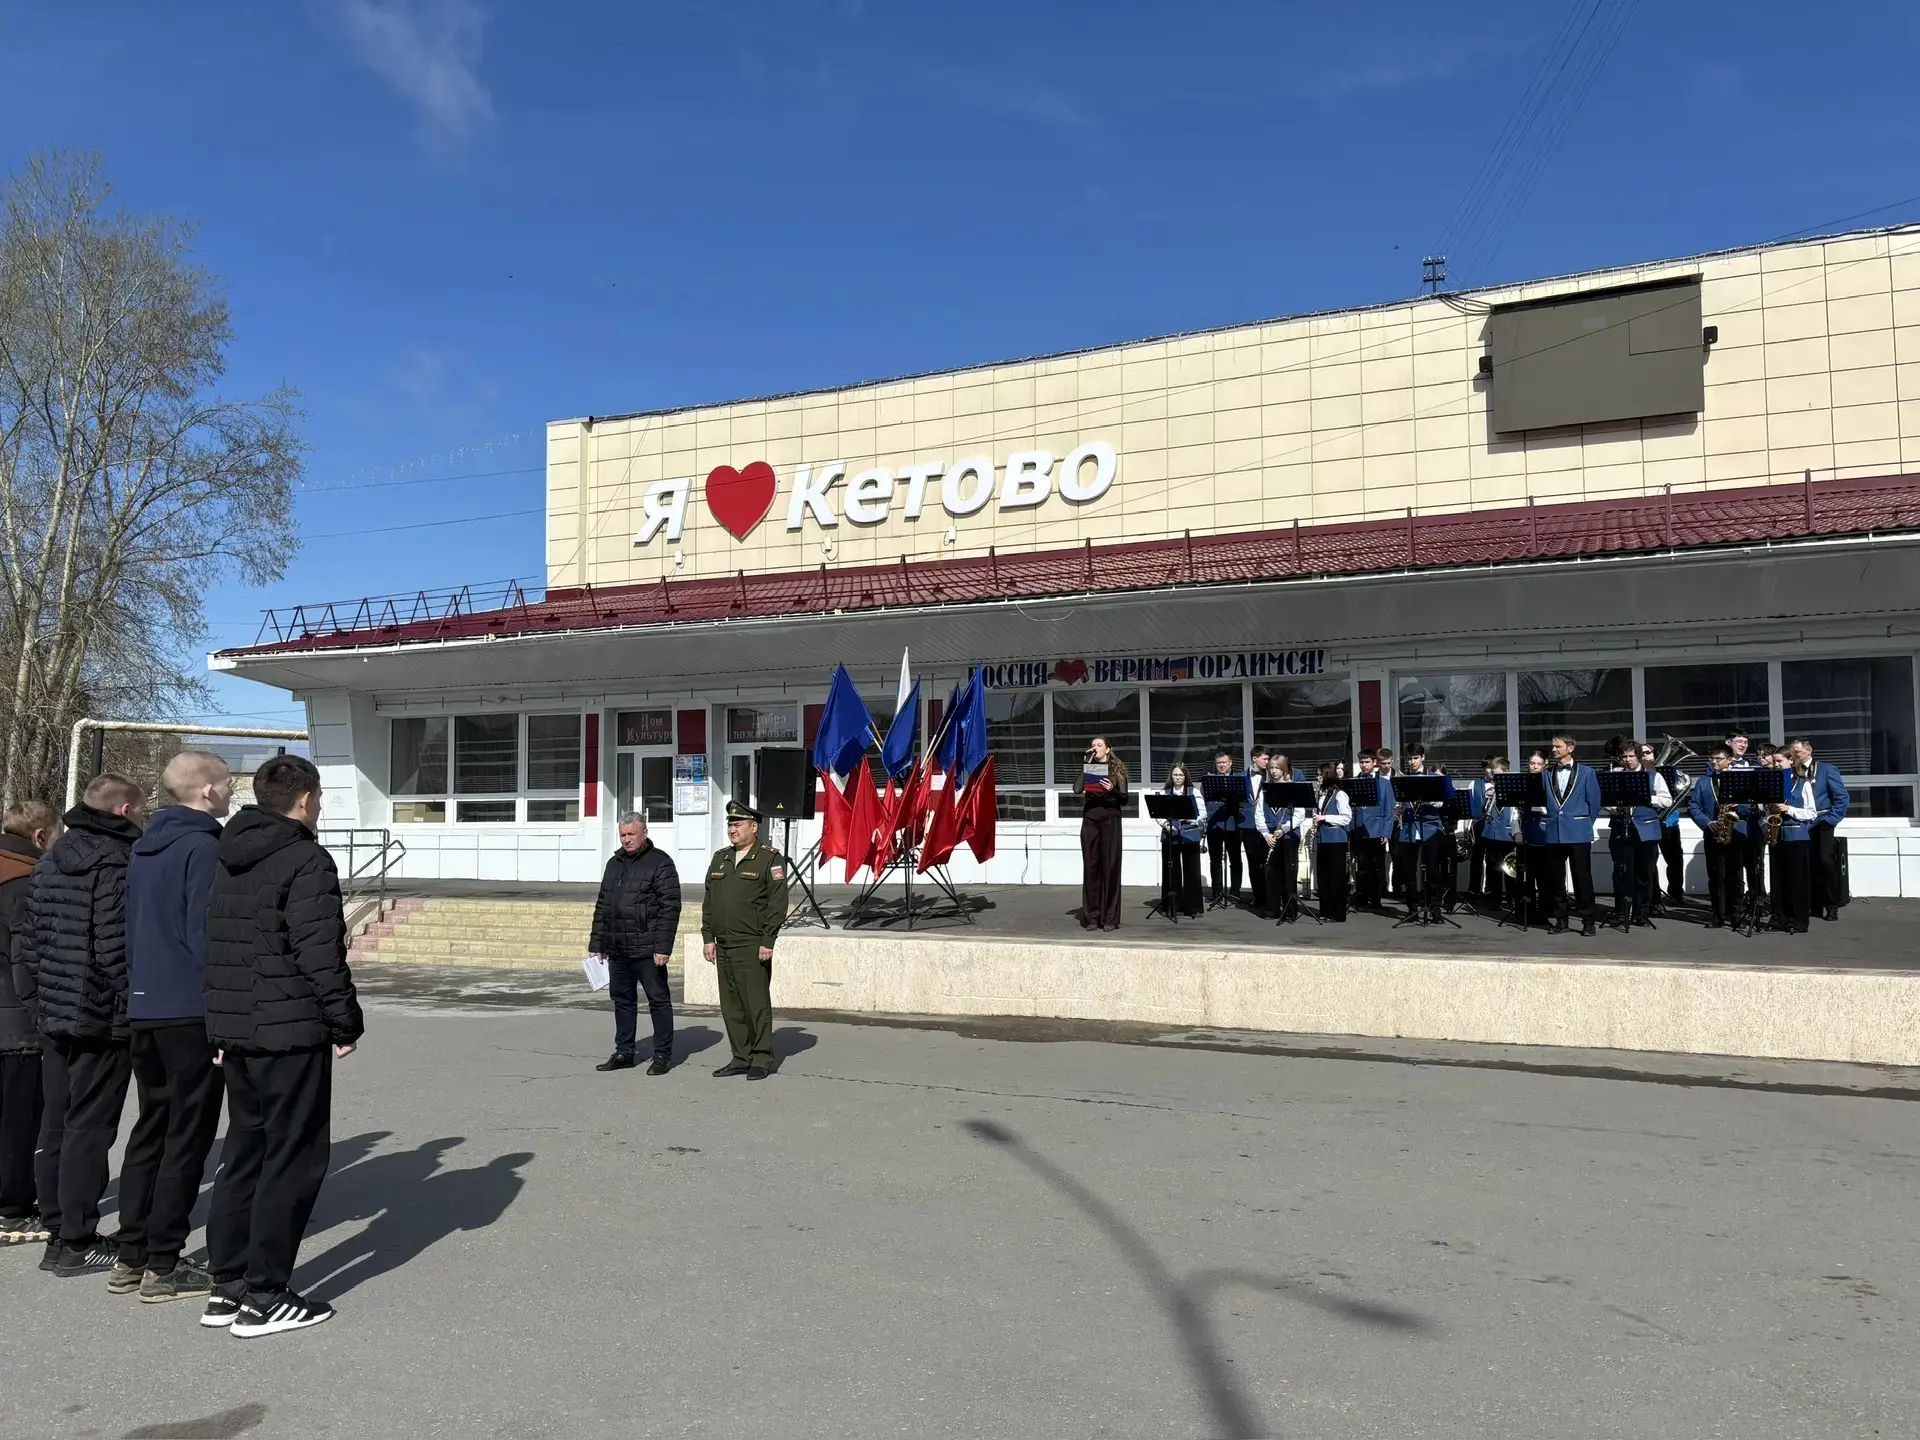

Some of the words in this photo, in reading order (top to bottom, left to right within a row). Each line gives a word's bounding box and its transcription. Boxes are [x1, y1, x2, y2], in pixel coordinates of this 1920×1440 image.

[633, 476, 692, 547] Я
[786, 440, 1117, 531] Кетово
[1094, 656, 1178, 683] ВЕРИМ,
[1187, 649, 1324, 680] ГОРДИМСЯ!
[641, 712, 663, 731] Дом
[751, 711, 787, 730] Добро
